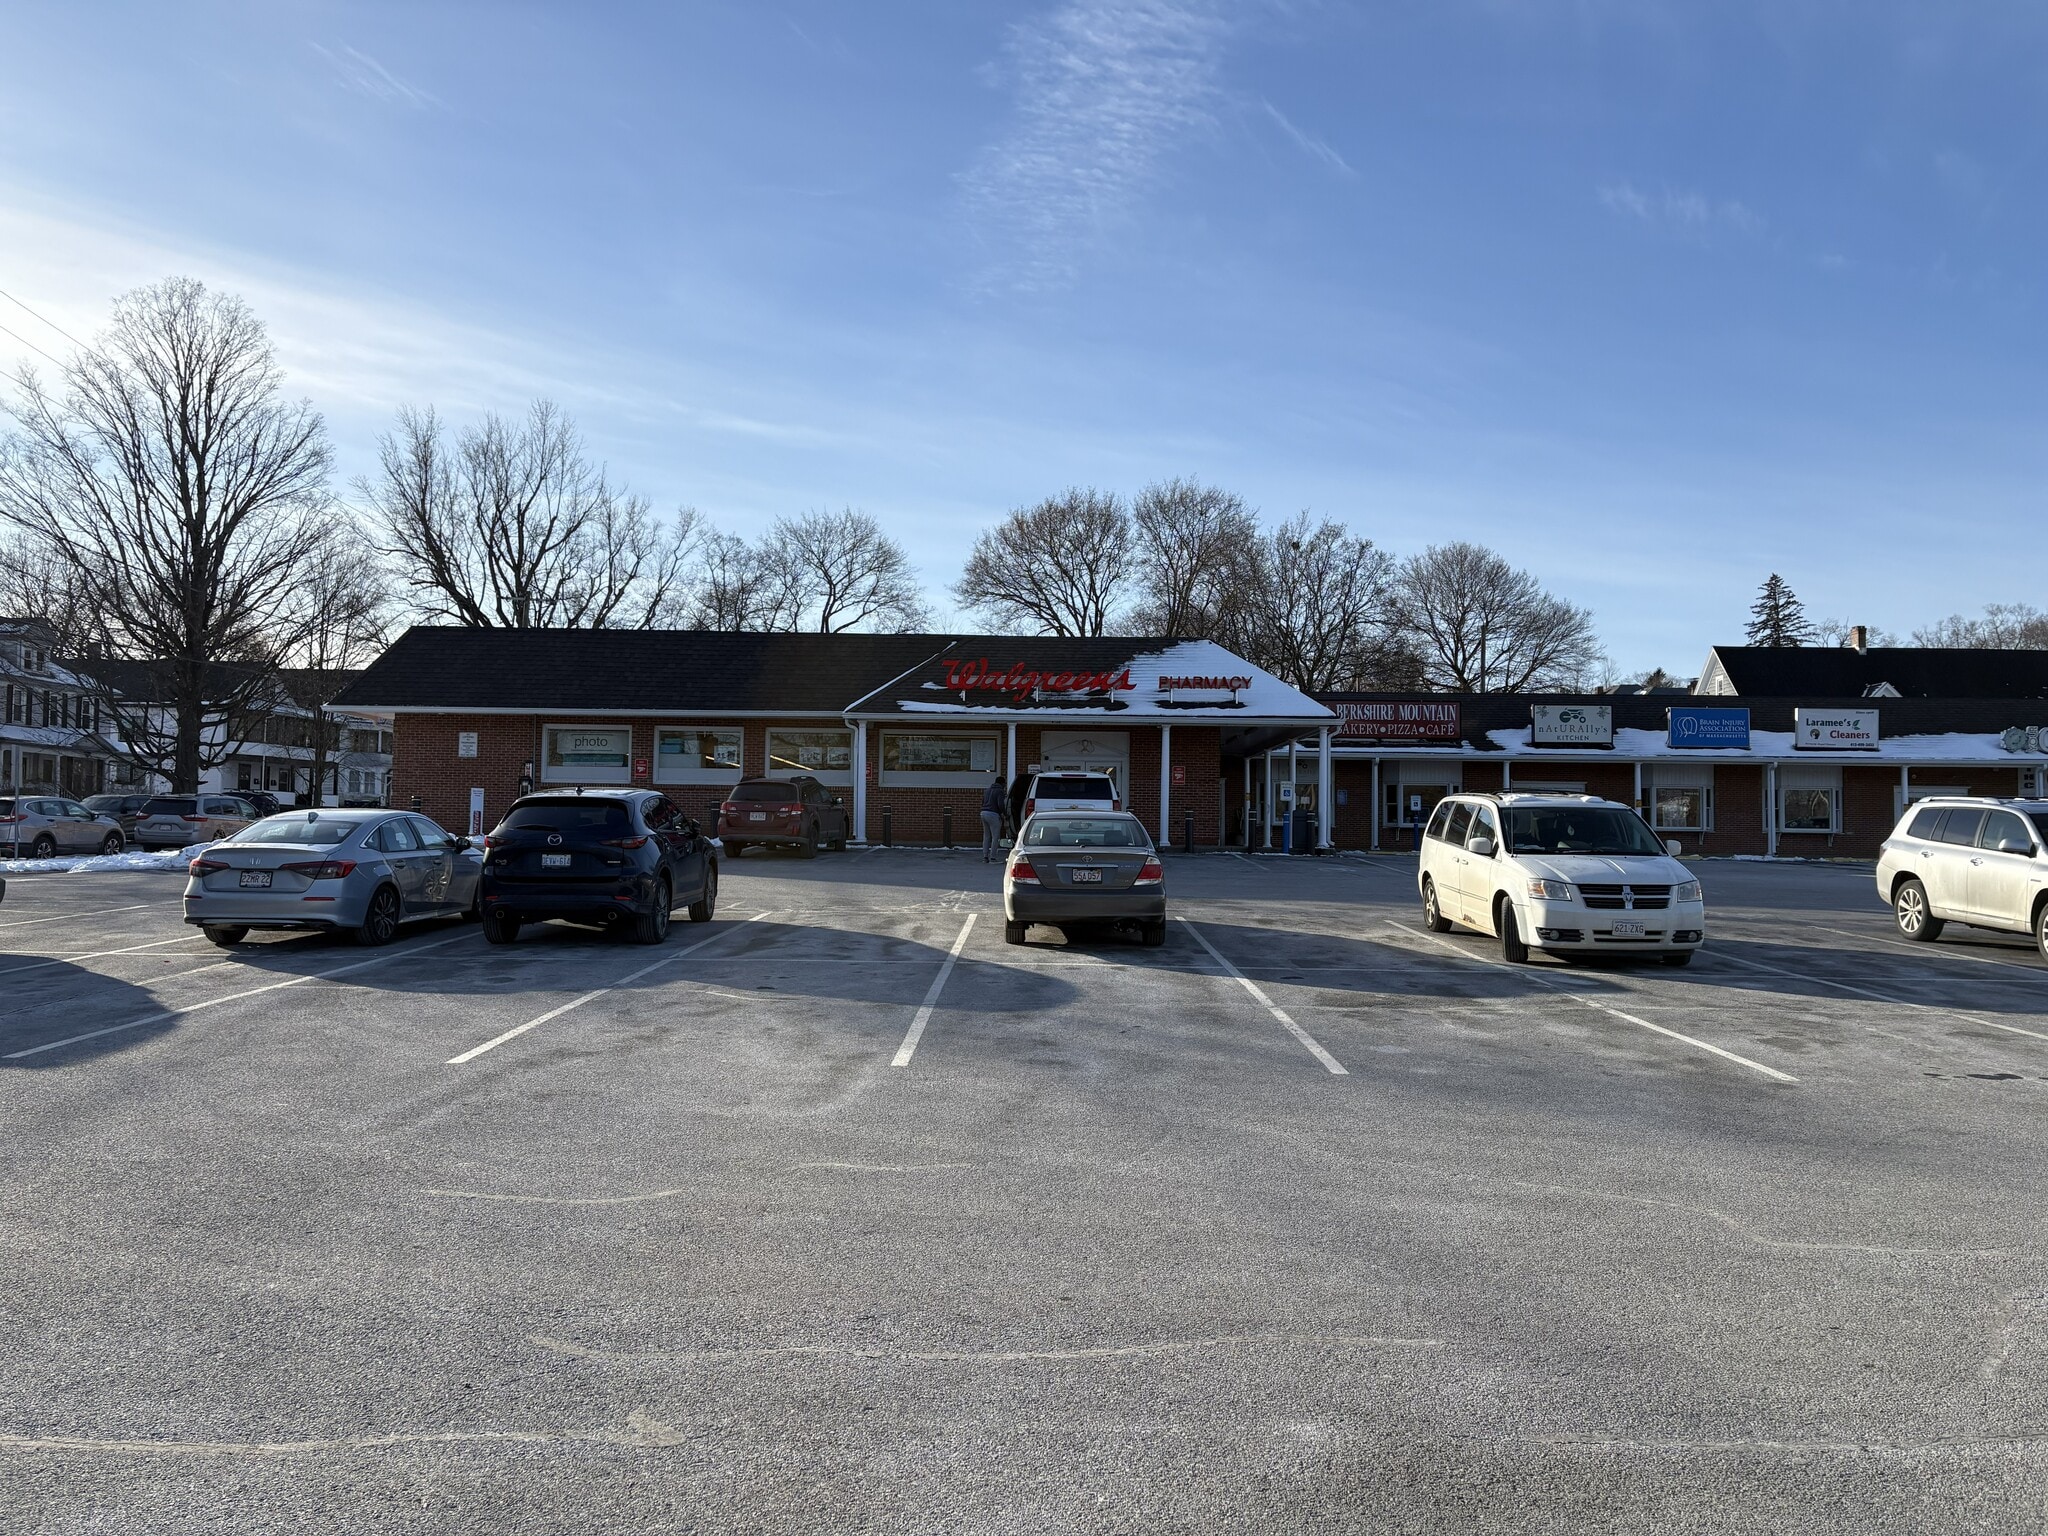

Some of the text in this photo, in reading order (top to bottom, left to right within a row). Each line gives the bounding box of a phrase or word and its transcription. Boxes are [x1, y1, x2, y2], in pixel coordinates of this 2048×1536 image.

[941, 658, 1138, 702] Walgreens
[1159, 676, 1253, 690] PHARMACY
[1336, 704, 1457, 721] BERKSHIRE MOUNTAIN
[1387, 724, 1418, 735] PIZZA
[1426, 722, 1455, 735] CAFÉ
[1806, 718, 1851, 727] Laramee's
[1829, 730, 1870, 739] Cleaners
[574, 736, 608, 749] photo
[1614, 924, 1629, 933] 621
